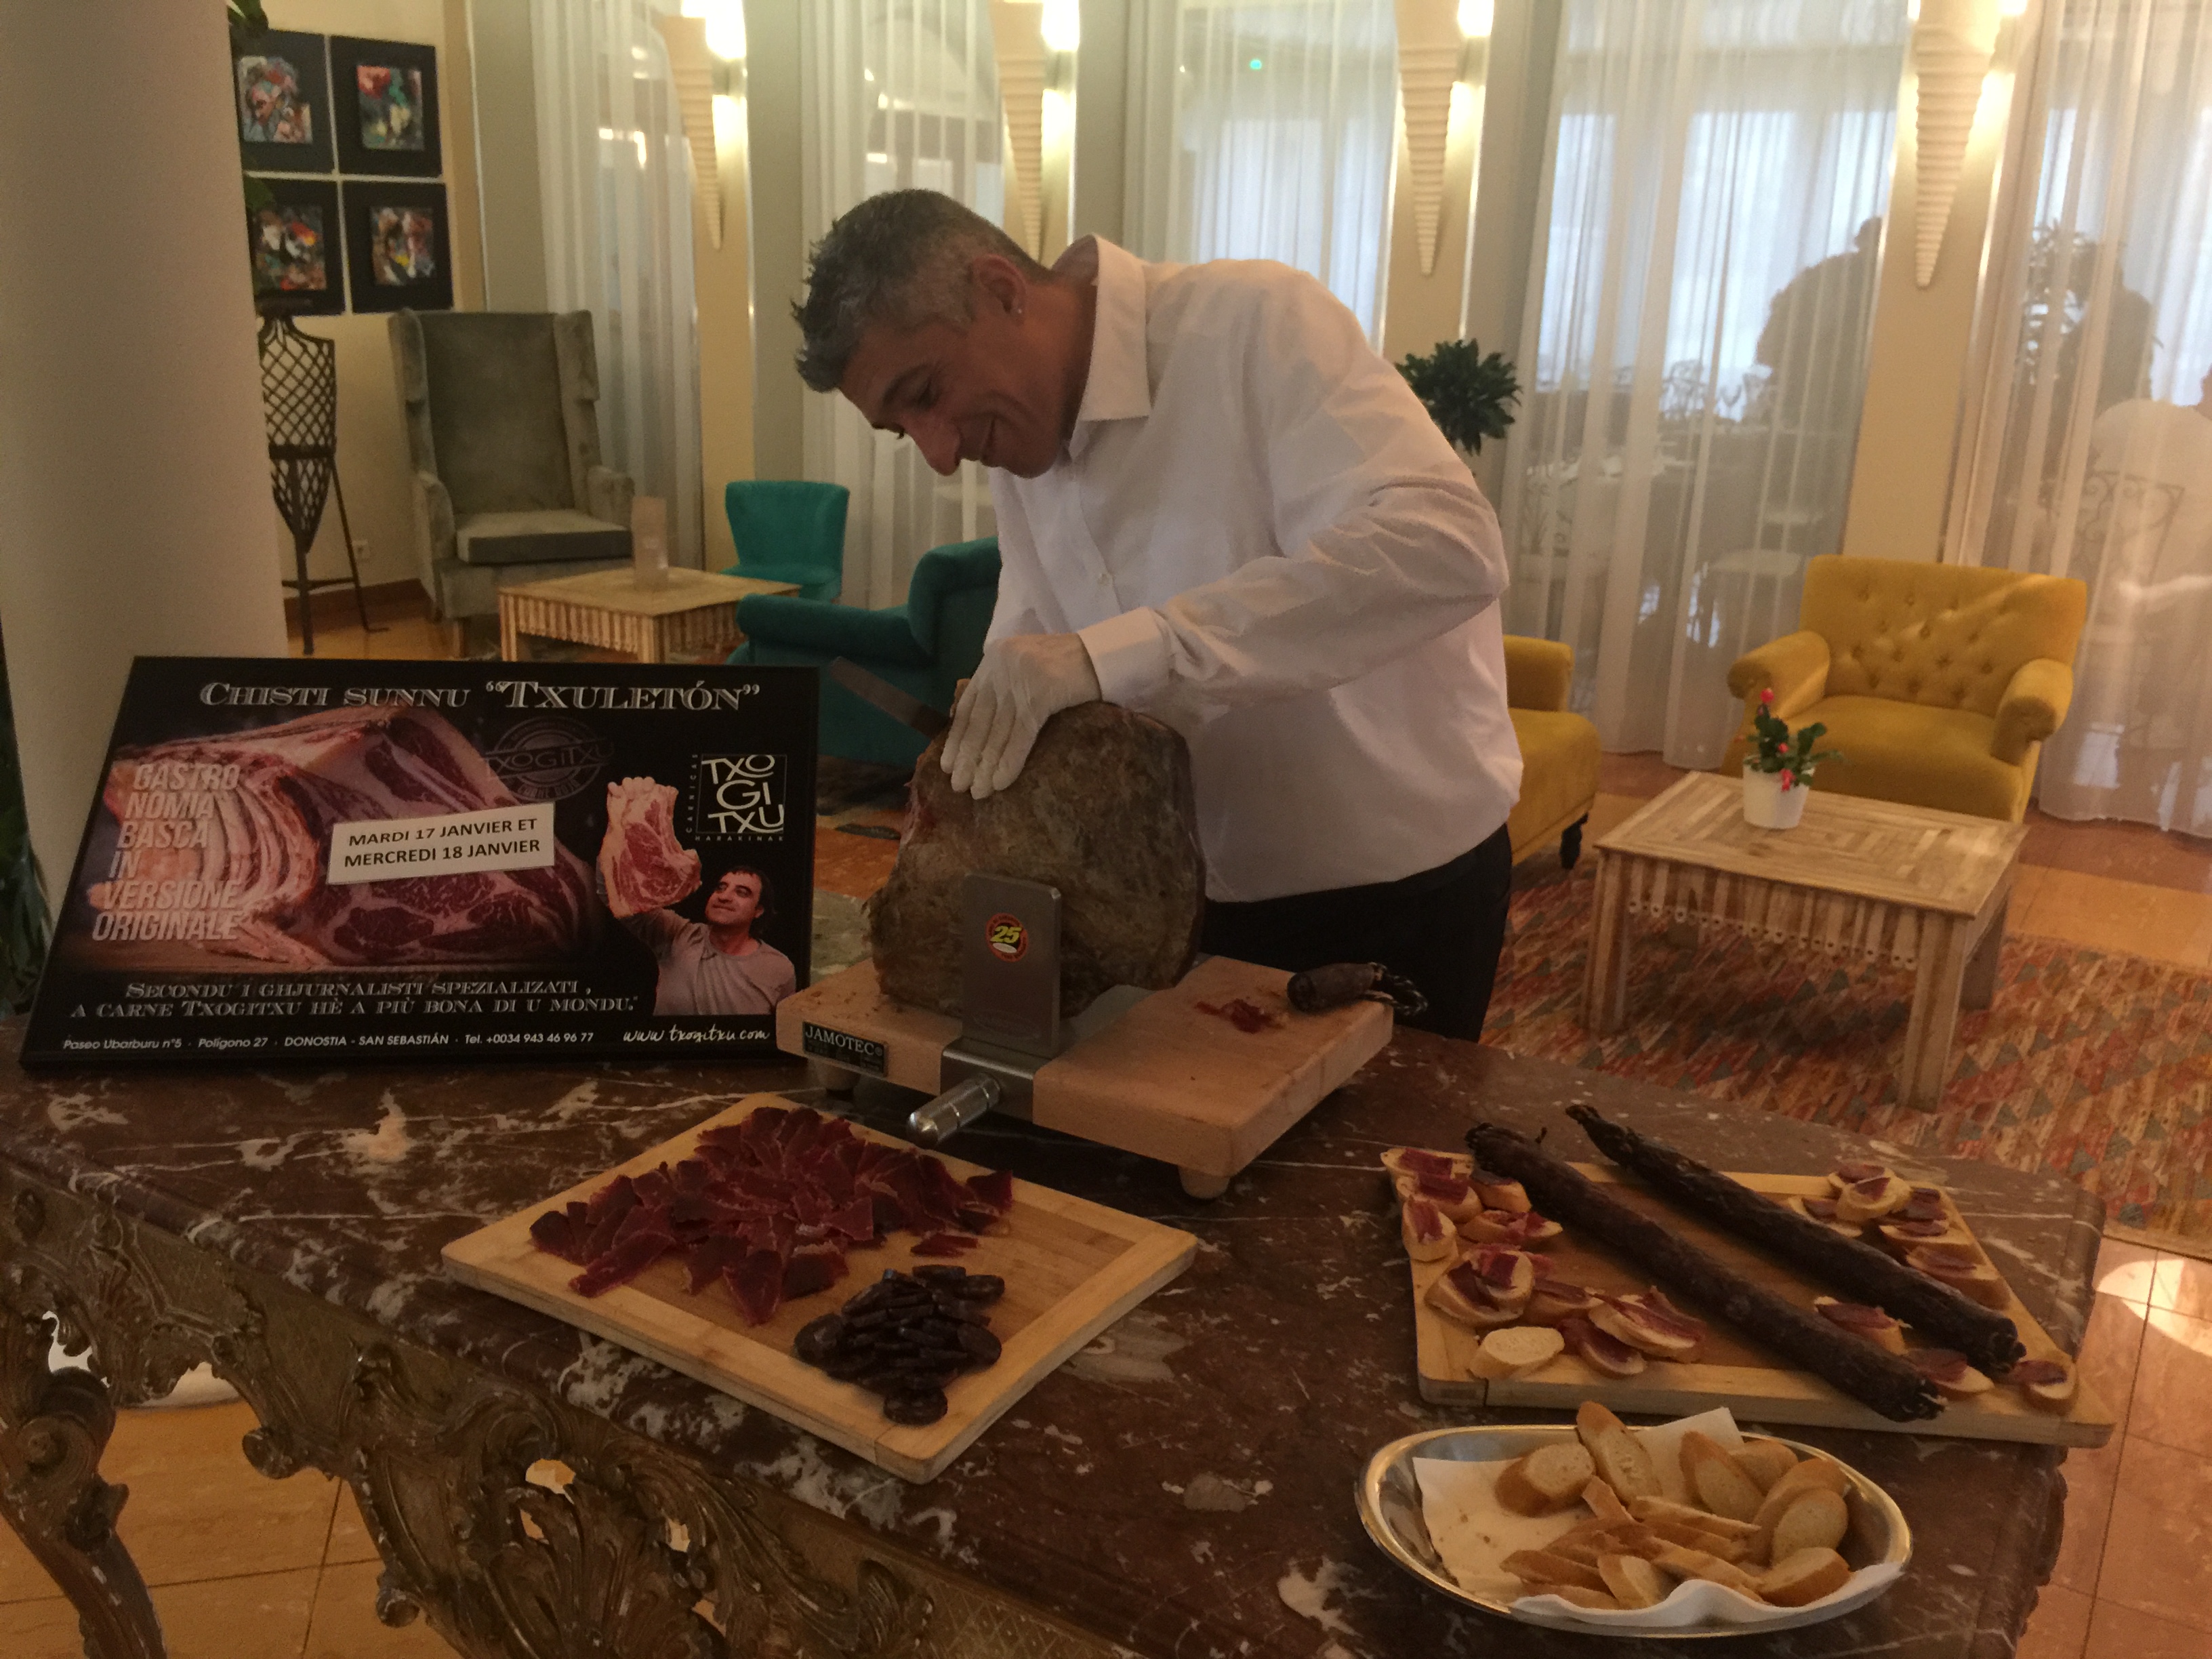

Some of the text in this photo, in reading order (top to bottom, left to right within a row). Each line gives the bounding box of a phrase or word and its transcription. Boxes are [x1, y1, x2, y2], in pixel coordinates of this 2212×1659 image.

[200, 682, 331, 706] CHISTI
[344, 687, 472, 708] SUNNU
[133, 763, 241, 790] GASTRO
[701, 754, 775, 785] TXO
[124, 791, 215, 819] NOMIA
[716, 779, 772, 810] GI
[348, 818, 537, 846] MARDI 17 JANVIER ET
[707, 804, 785, 834] TXU
[117, 821, 209, 848] BASCA
[108, 851, 142, 878] IN
[344, 839, 541, 867] MERCREDI 18 JANVIER
[103, 880, 243, 909] VERSIONE
[92, 909, 243, 941] ORIGINALE
[989, 925, 1023, 943] 25
[125, 982, 234, 998] SECONDU
[258, 981, 424, 998] GHJURNALISTI
[70, 1004, 87, 1018] A
[95, 1003, 174, 1018] CARNE
[181, 1000, 302, 1017] TXOGITXU
[350, 1000, 366, 1015] A
[375, 996, 415, 1015] PIÙ
[423, 998, 484, 1014] BONA
[492, 998, 517, 1013] DI
[526, 998, 542, 1013] U
[62, 1039, 101, 1050] Paseo
[103, 1038, 160, 1050] Ubarburu
[197, 1036, 251, 1050] Polígono
[253, 1037, 269, 1048] 27
[283, 1036, 347, 1047] DONOSTIA
[358, 1035, 385, 1046] SAN
[386, 1031, 450, 1046] SEBASTIÁN
[464, 1033, 483, 1044] Tel.
[486, 1033, 521, 1044] +0034
[523, 1032, 544, 1044] 943
[546, 1032, 561, 1043] 46
[563, 1032, 577, 1043] 96
[580, 1031, 594, 1043] 77
